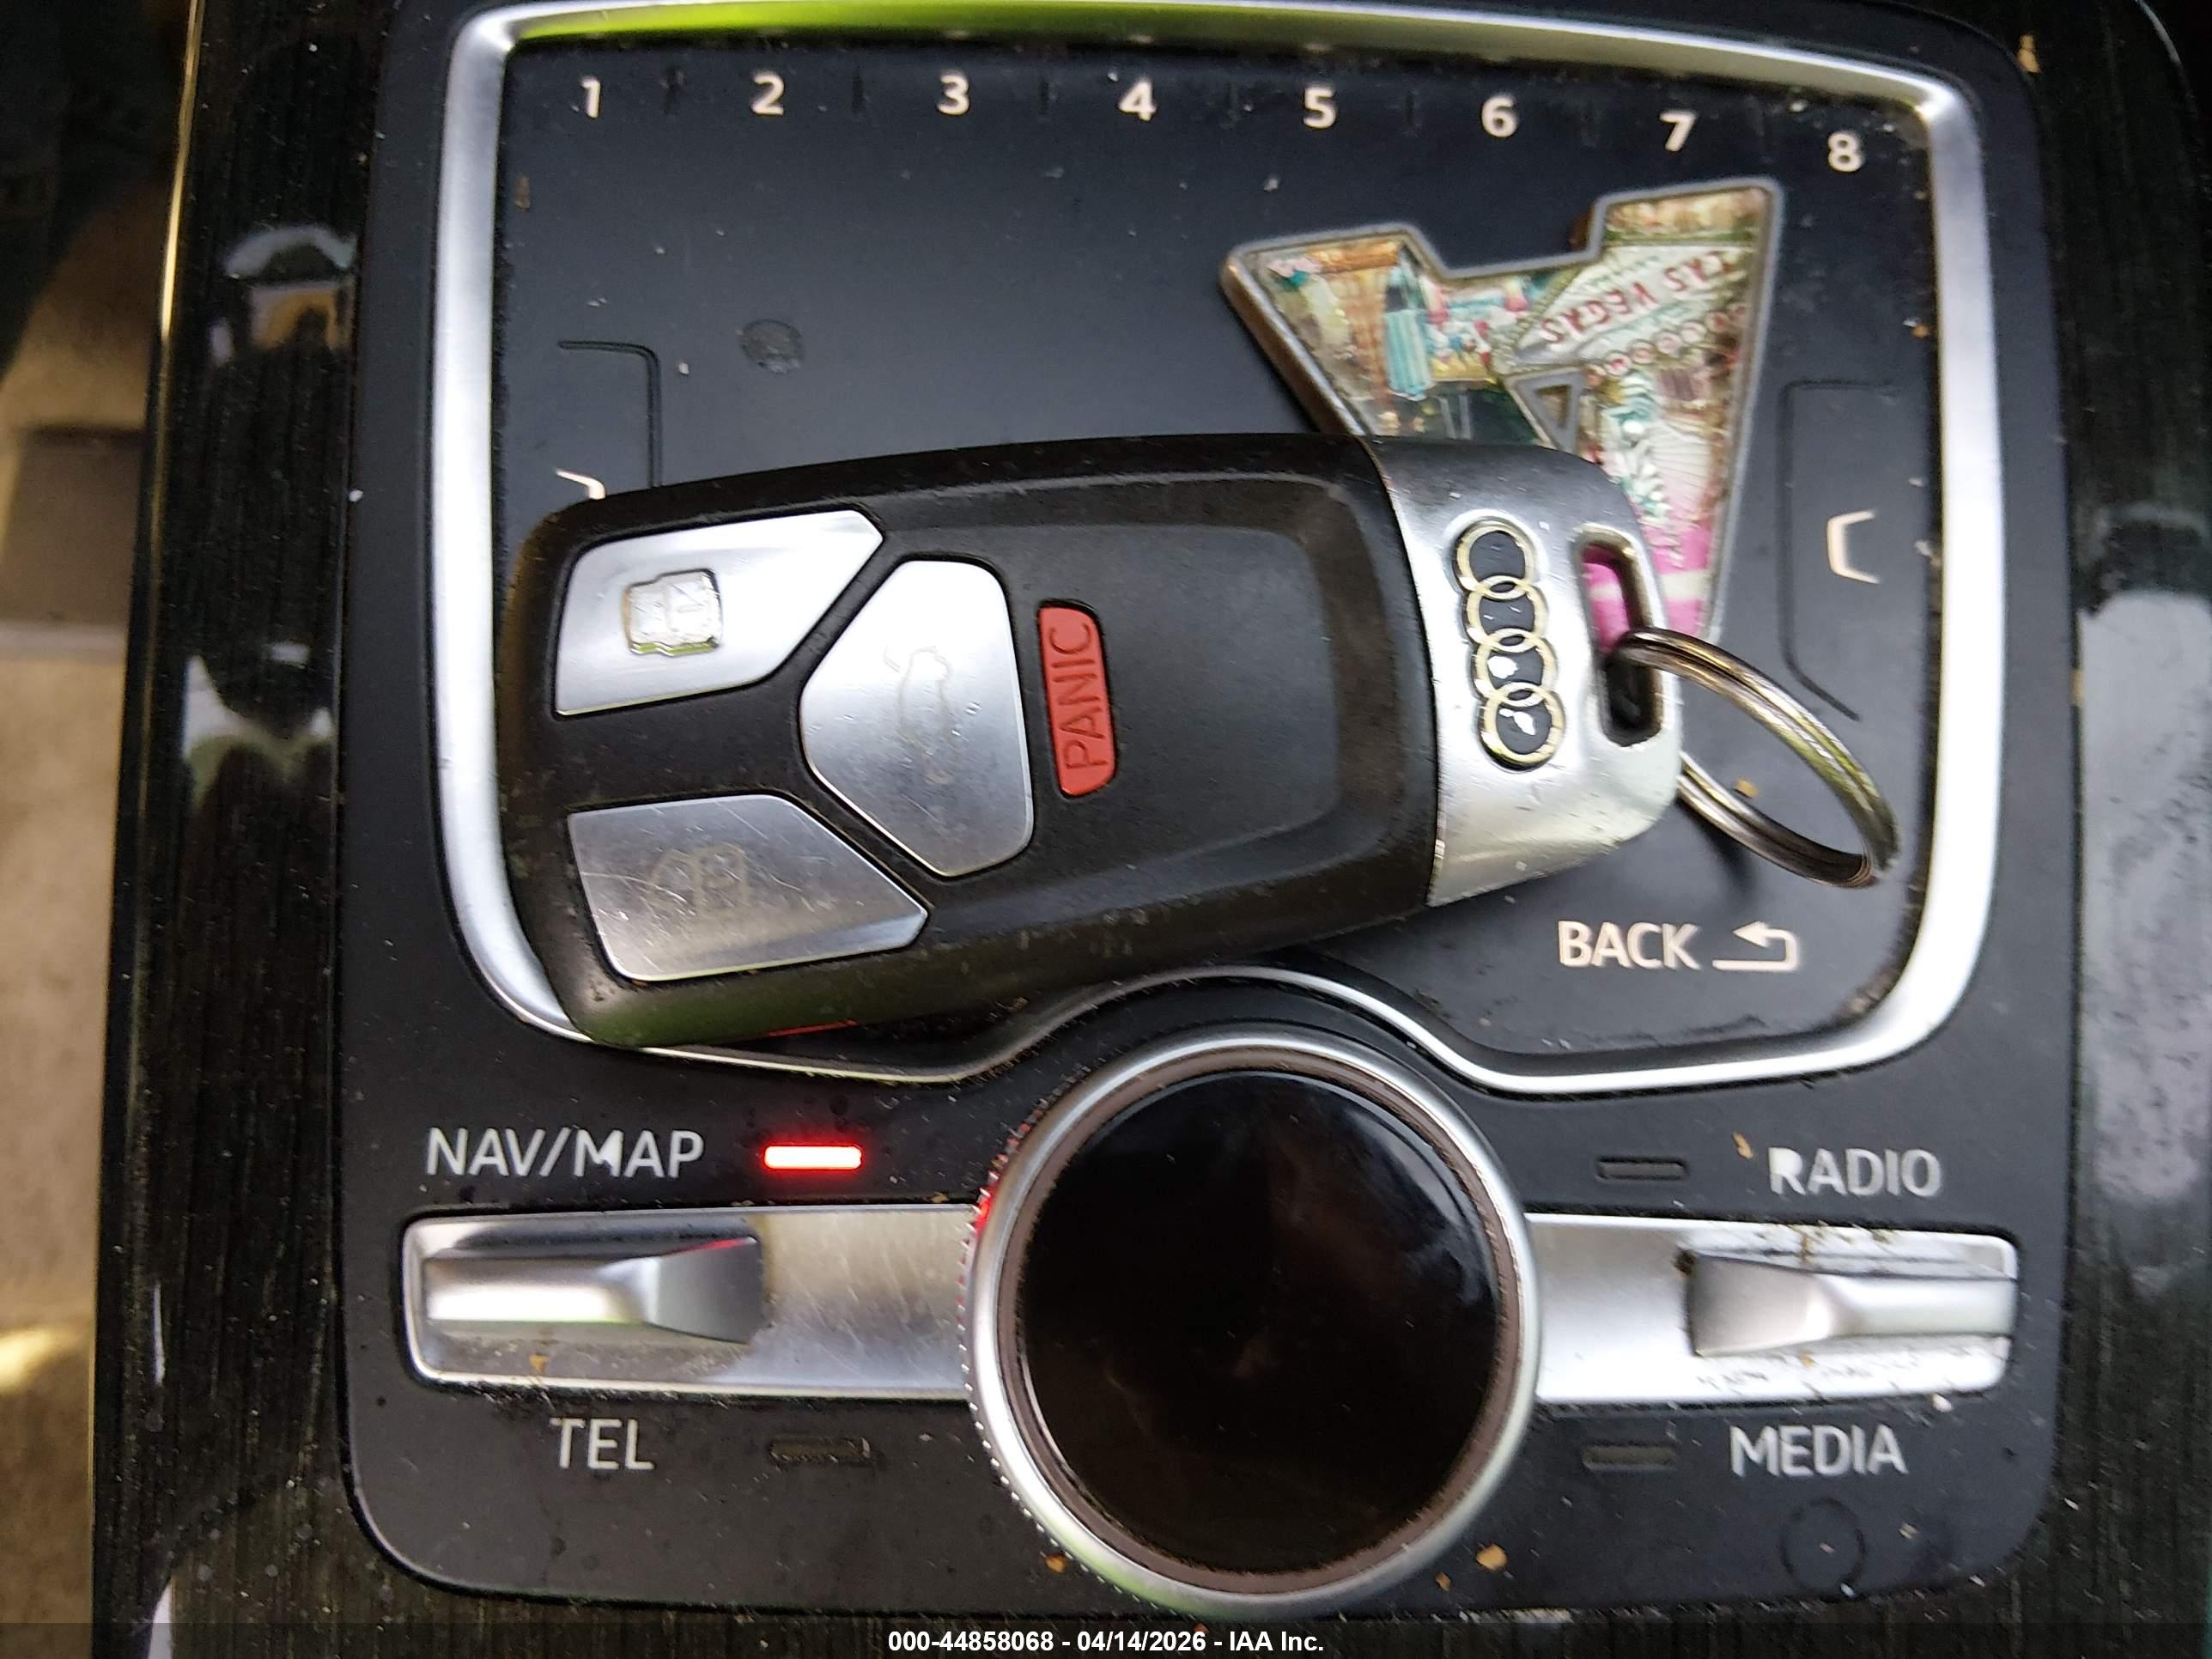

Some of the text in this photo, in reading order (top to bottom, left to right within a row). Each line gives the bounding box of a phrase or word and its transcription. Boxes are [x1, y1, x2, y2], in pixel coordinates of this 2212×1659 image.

[580, 71, 1863, 173] 1 2 3 4 5 6 7 8
[1048, 623, 1109, 770] PANIC
[1557, 920, 1702, 971] BACK
[425, 1127, 704, 1179] NAV/MAP
[1767, 1146, 1943, 1198] RADIO
[549, 1417, 656, 1471] TEL
[1729, 1423, 1909, 1478] MEDIA
